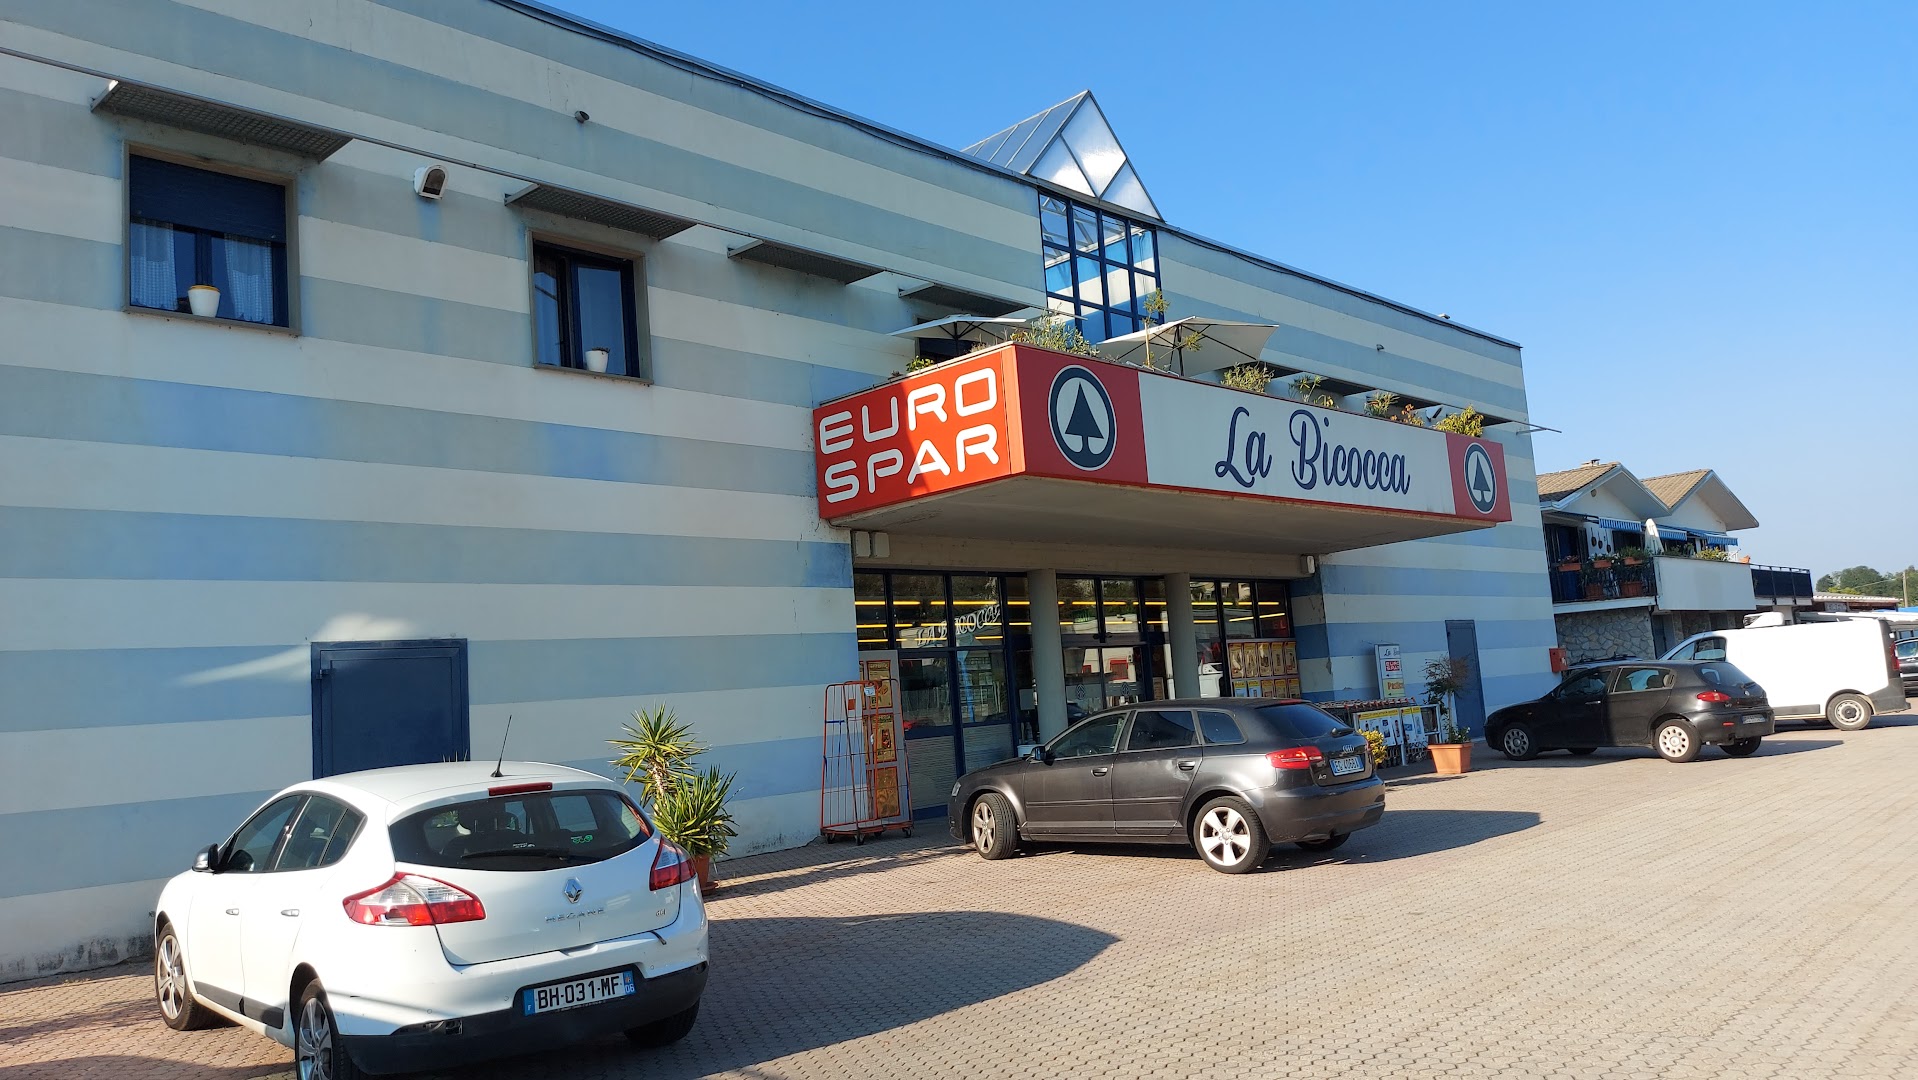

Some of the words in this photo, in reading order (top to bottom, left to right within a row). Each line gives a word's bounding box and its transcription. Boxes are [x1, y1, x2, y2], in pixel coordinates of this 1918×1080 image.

[820, 367, 997, 455] EURO
[1214, 407, 1272, 488] La
[1289, 409, 1410, 495] Bicocca
[825, 423, 999, 503] SPAR
[537, 975, 620, 1010] BH-031-MF
[625, 984, 635, 993] 06
